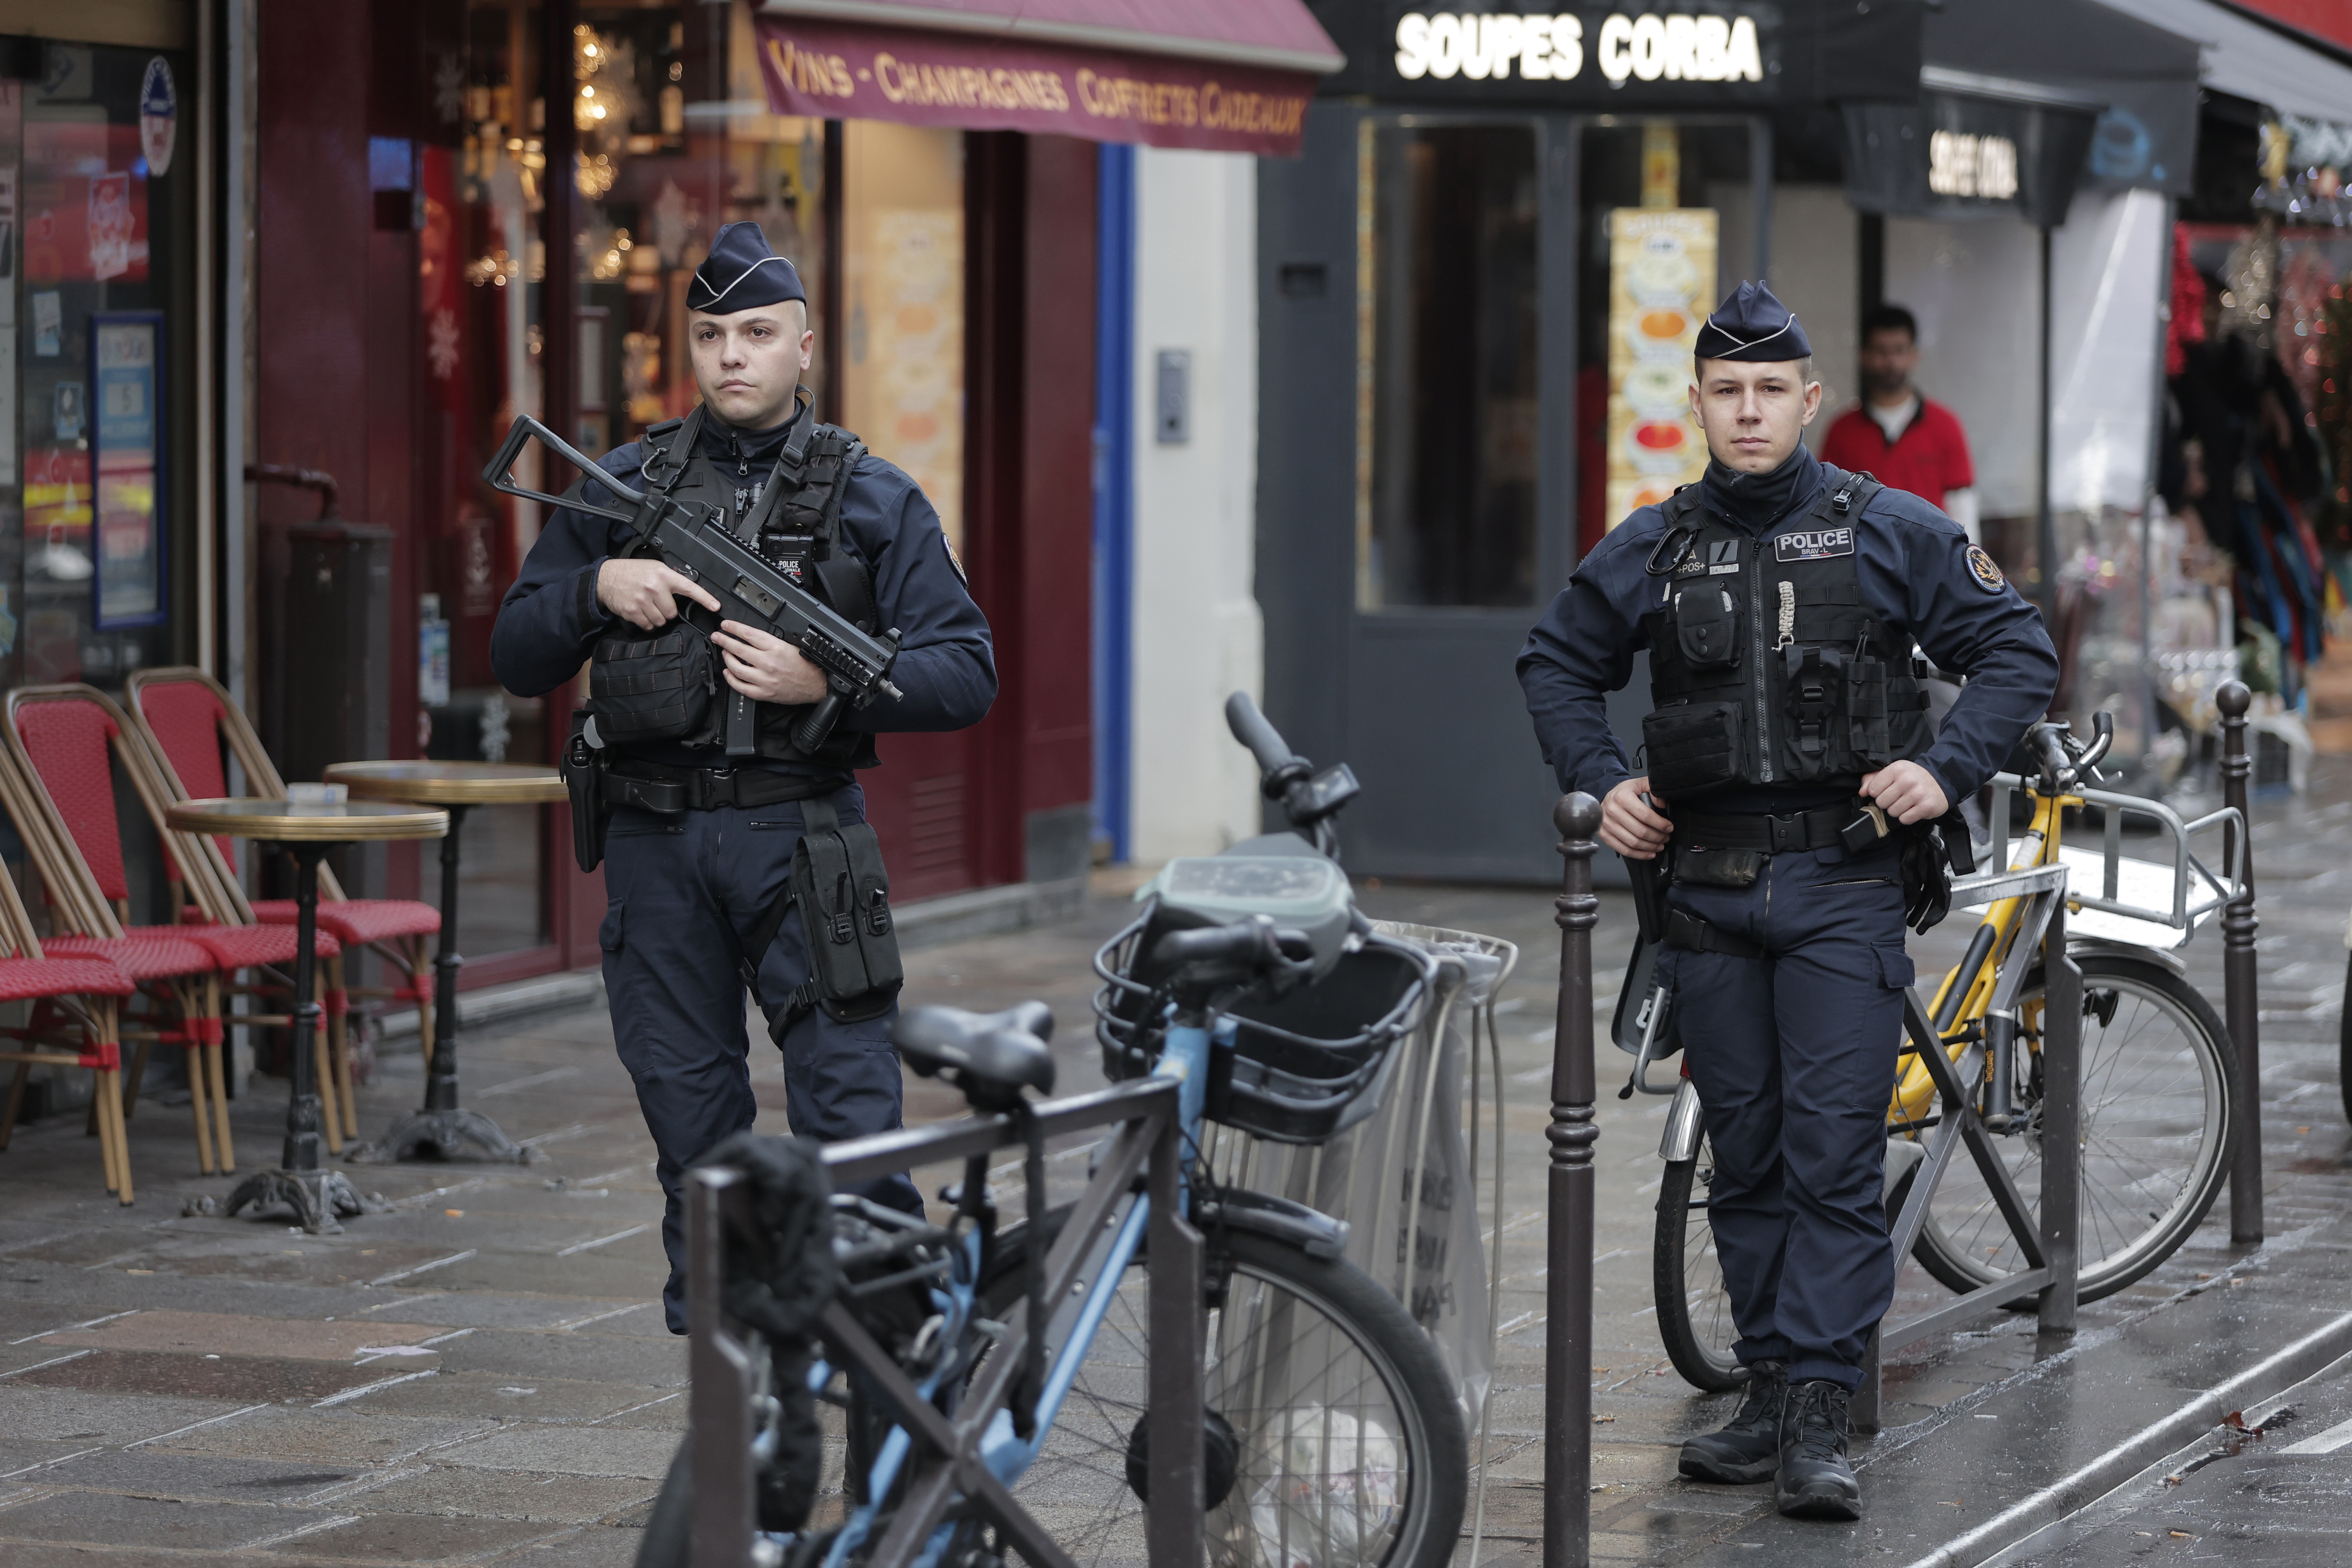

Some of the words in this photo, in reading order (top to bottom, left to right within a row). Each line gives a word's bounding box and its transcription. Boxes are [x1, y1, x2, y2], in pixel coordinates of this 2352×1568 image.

[1394, 12, 1584, 81] SOUPES
[1598, 12, 1764, 82] CORBA
[766, 40, 855, 98] VINS
[873, 51, 1070, 113] CHAMPAGNES
[1075, 67, 1199, 128] COFFRETS
[1200, 80, 1306, 136] CADEAUX
[1780, 530, 1850, 551] POLICE
[1711, 565, 1737, 574] 1498282
